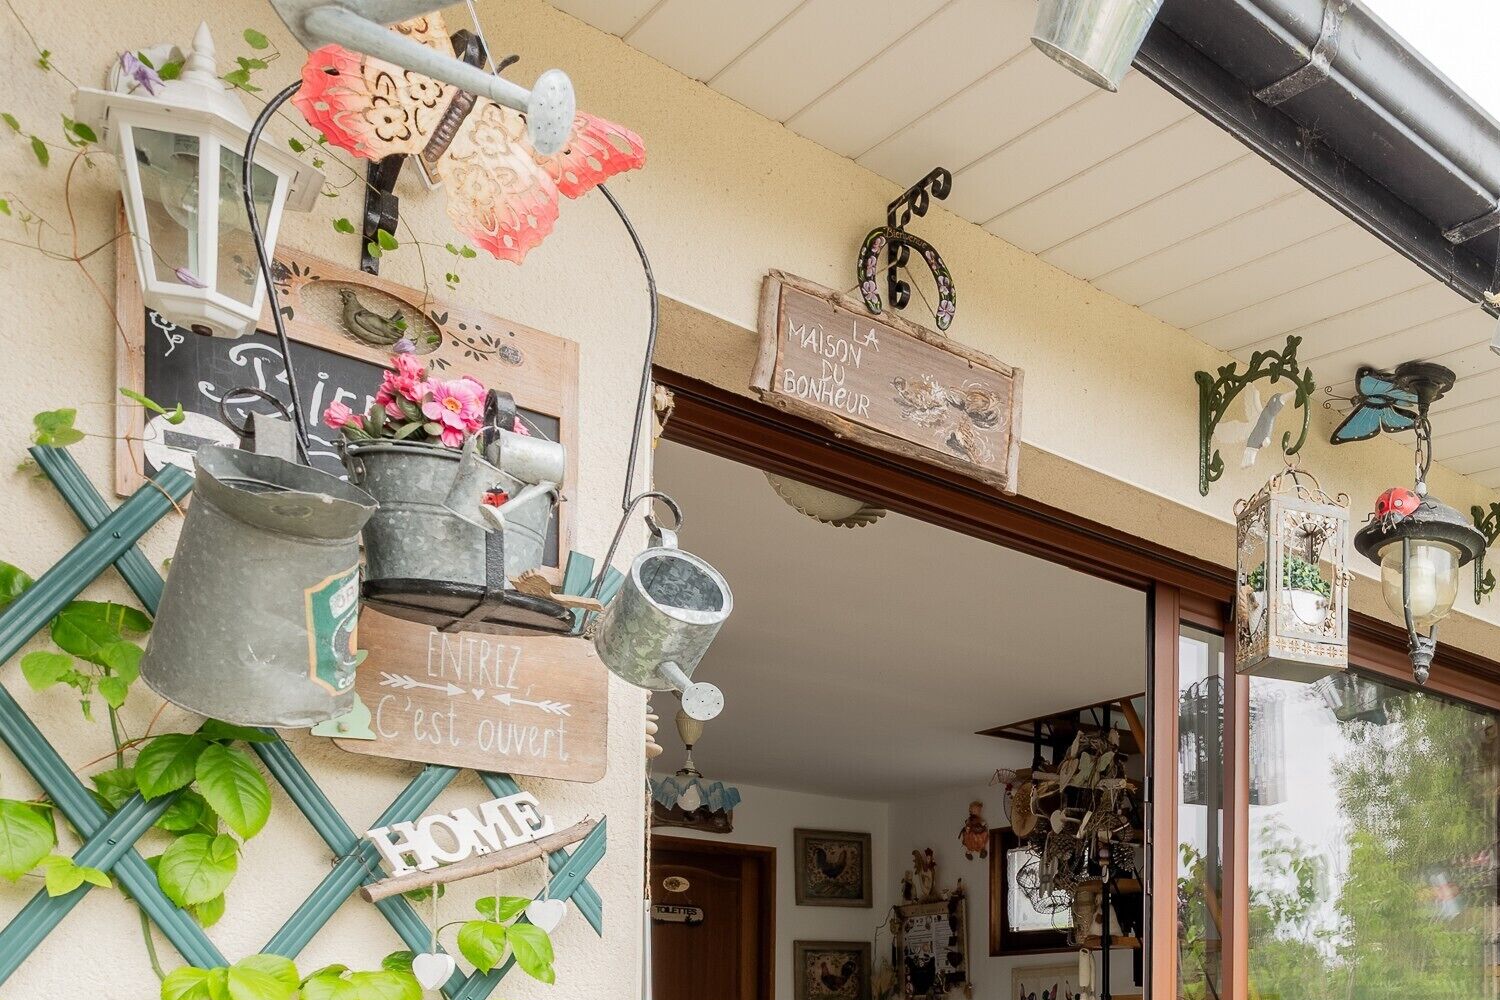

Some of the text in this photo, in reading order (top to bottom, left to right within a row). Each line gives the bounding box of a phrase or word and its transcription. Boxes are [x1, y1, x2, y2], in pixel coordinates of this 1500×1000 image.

[852, 320, 880, 352] LA
[820, 358, 846, 385] DU
[376, 694, 569, 762] C'est ouvert
[366, 790, 555, 877] HOME
[656, 906, 698, 916] TOILETTES
